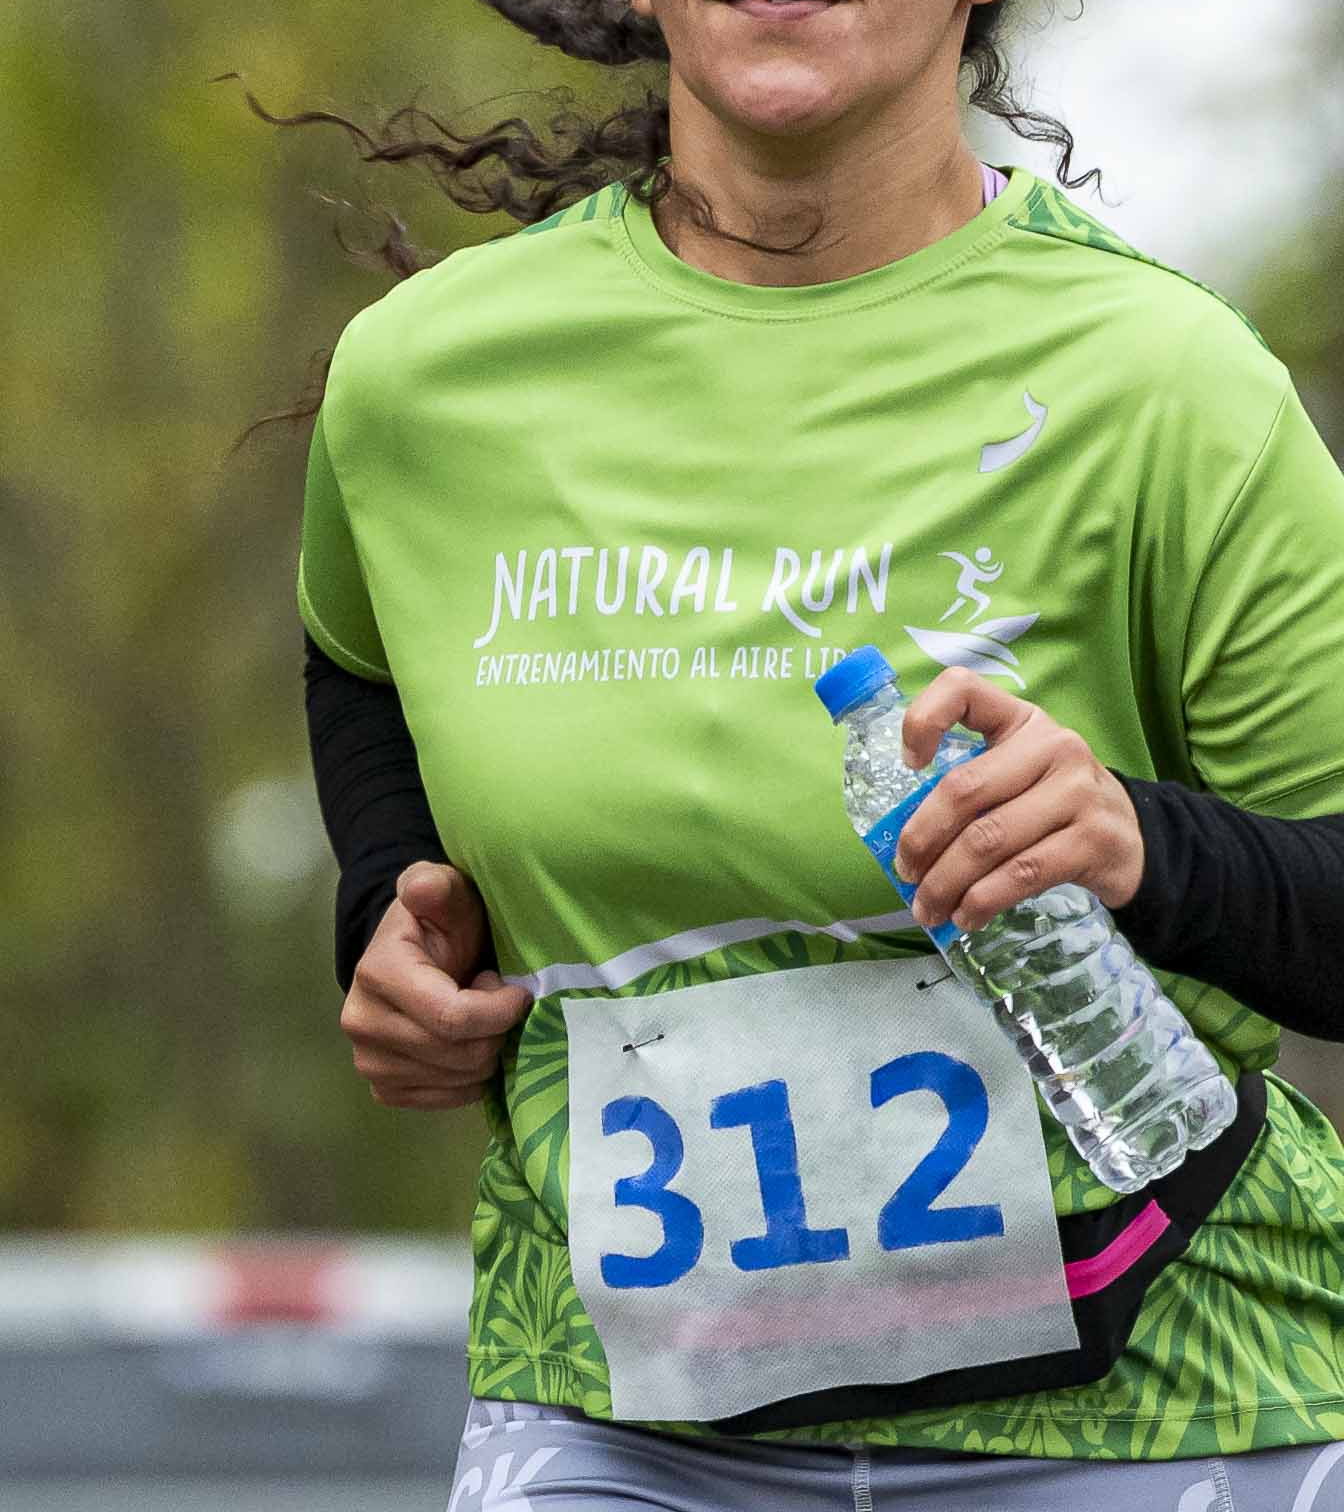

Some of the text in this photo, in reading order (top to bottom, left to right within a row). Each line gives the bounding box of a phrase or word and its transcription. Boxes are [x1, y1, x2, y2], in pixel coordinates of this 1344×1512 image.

[473, 542, 893, 648] NATURAL RUN
[476, 648, 680, 687] ENTRENAMIENTO
[690, 647, 720, 679] AL
[730, 647, 793, 679] AIRE
[600, 1050, 1004, 1289] 312
